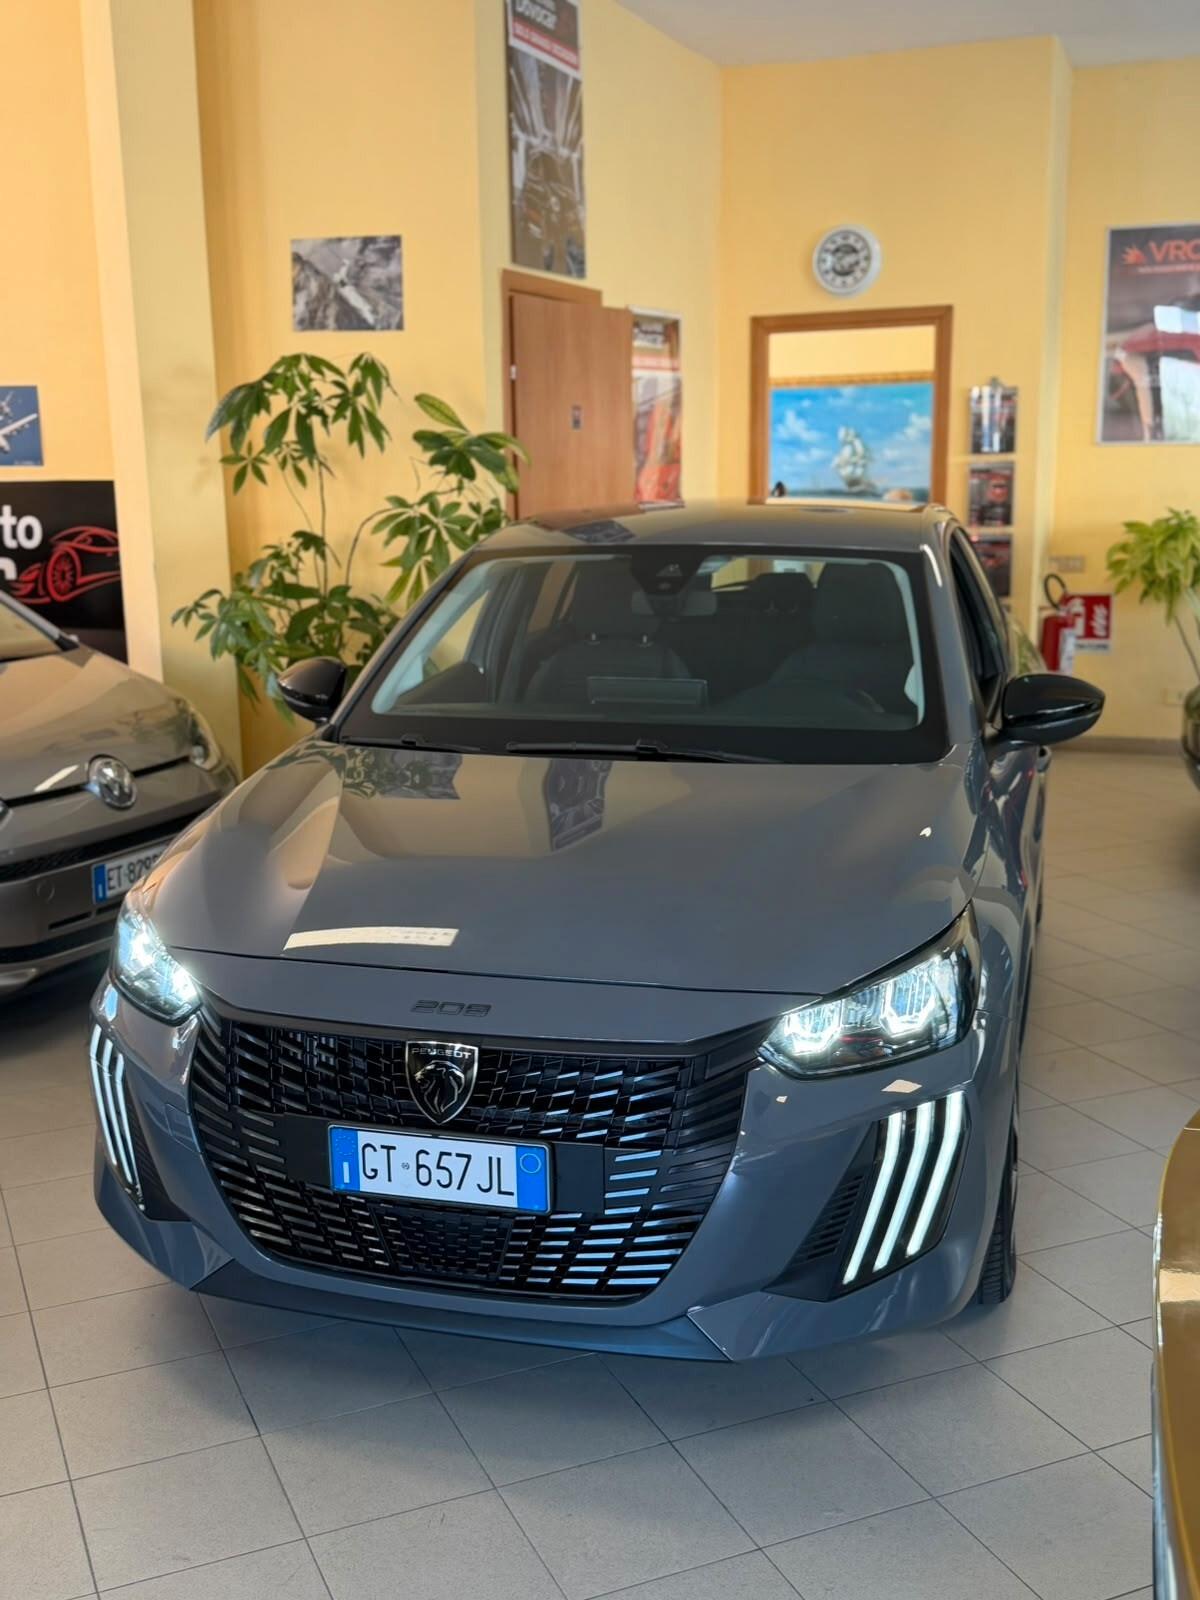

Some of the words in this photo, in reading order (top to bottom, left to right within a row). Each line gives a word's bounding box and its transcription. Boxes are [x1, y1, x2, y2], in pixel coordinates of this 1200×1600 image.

[0, 504, 43, 550] to
[410, 1000, 492, 1017] 208
[411, 1047, 471, 1059] PEUGEOT
[362, 1143, 397, 1183] GT
[415, 1149, 515, 1197] 657JL
